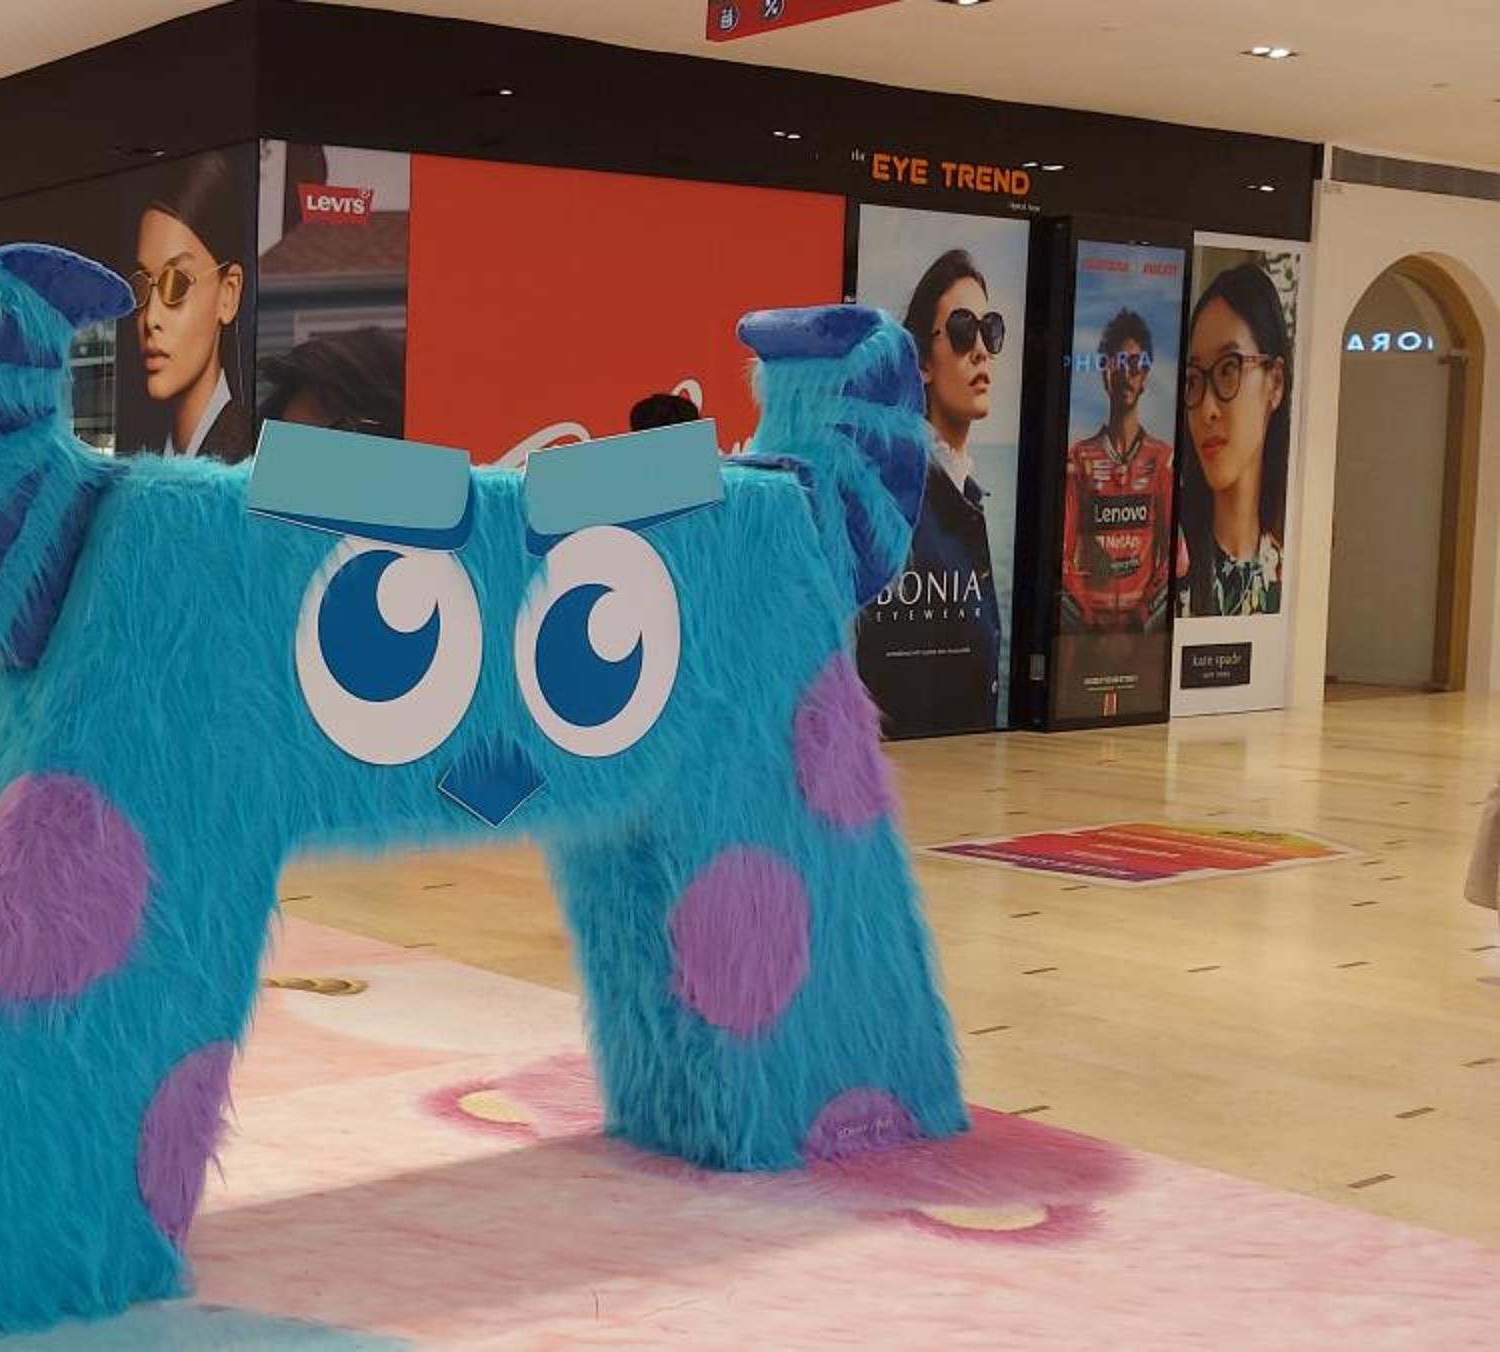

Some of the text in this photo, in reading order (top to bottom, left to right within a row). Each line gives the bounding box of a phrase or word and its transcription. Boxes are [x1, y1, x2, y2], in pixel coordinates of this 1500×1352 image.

[871, 152, 1030, 196] EYE TREND
[1094, 505, 1148, 524] Lenovo
